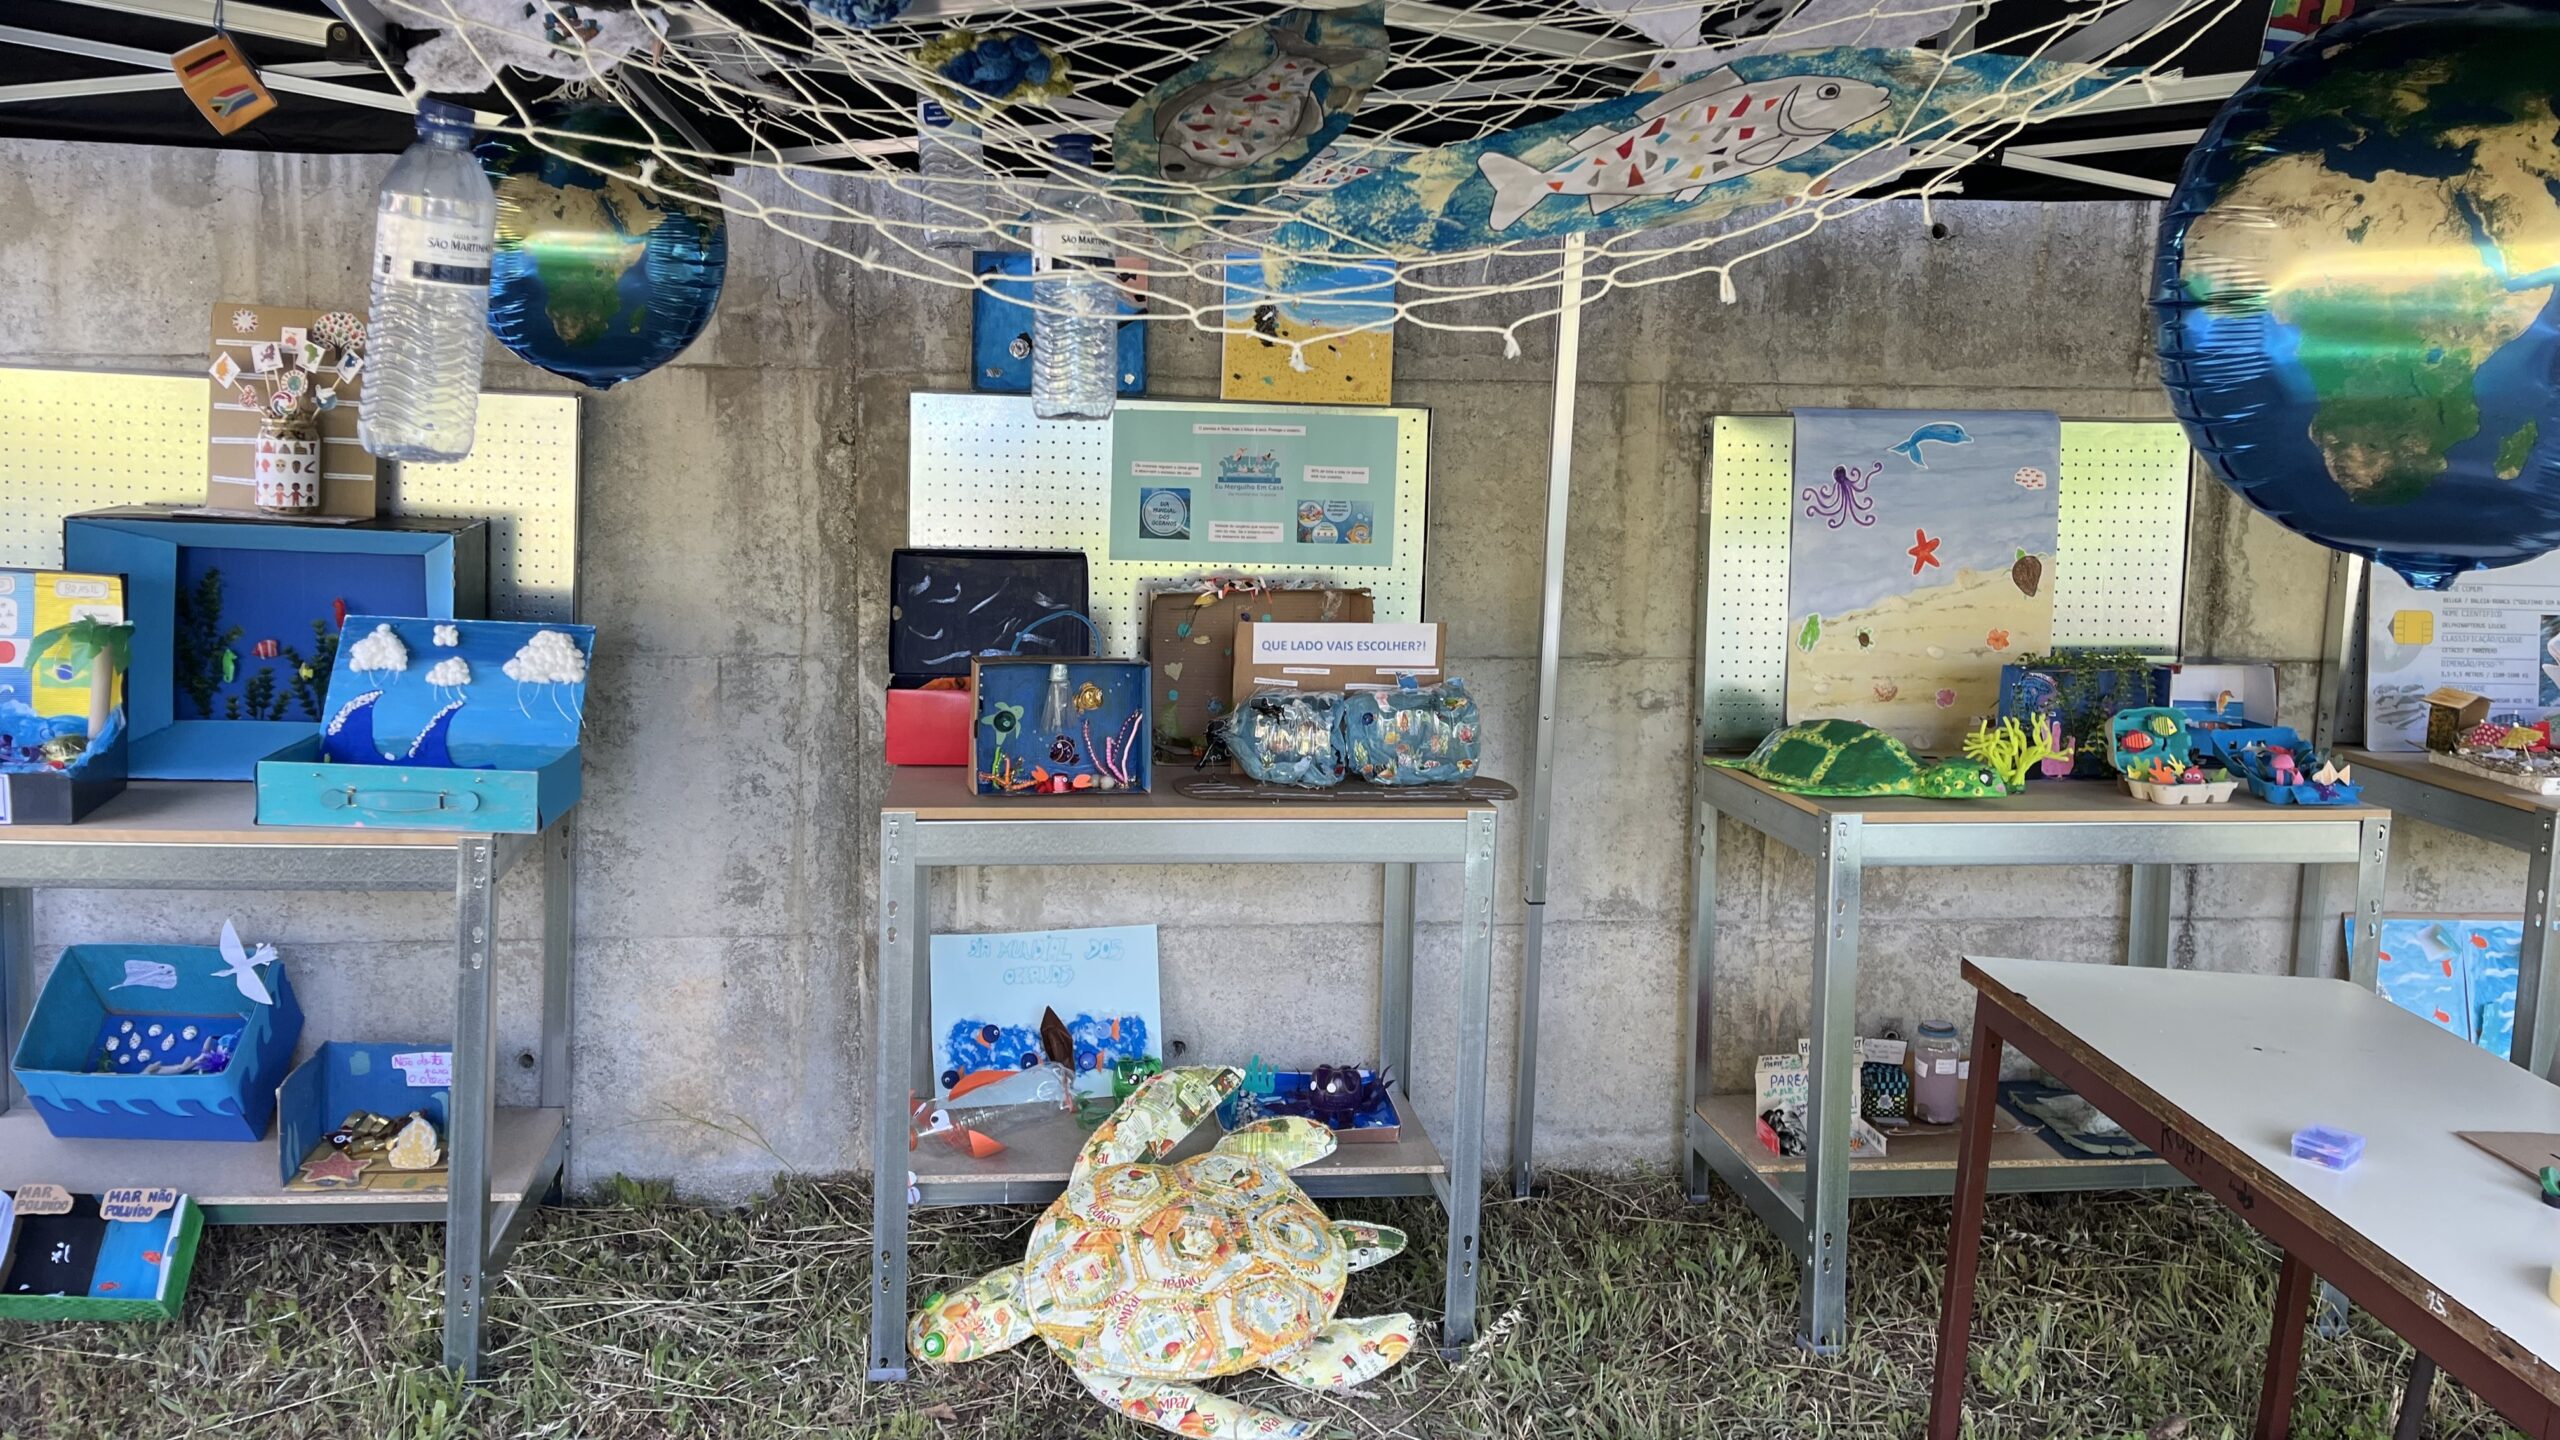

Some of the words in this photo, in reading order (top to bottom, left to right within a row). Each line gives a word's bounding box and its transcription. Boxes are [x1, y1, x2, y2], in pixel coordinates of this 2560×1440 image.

[428, 237, 449, 250] SÃO
[1061, 234, 1077, 244] SÃO
[1224, 483, 1255, 492] Mergulho
[1261, 640, 1287, 652] QUE
[1291, 640, 1323, 651] LADO
[1326, 641, 1353, 651] VAIS
[1357, 641, 1426, 652] ESCOLHER?!
[968, 937, 992, 958] DIA
[1084, 938, 1125, 961] DOS
[19, 1186, 53, 1199] MAR
[109, 1190, 142, 1203] MAR
[147, 1188, 173, 1203] NÃO
[104, 1204, 153, 1217] POLUÍDO
